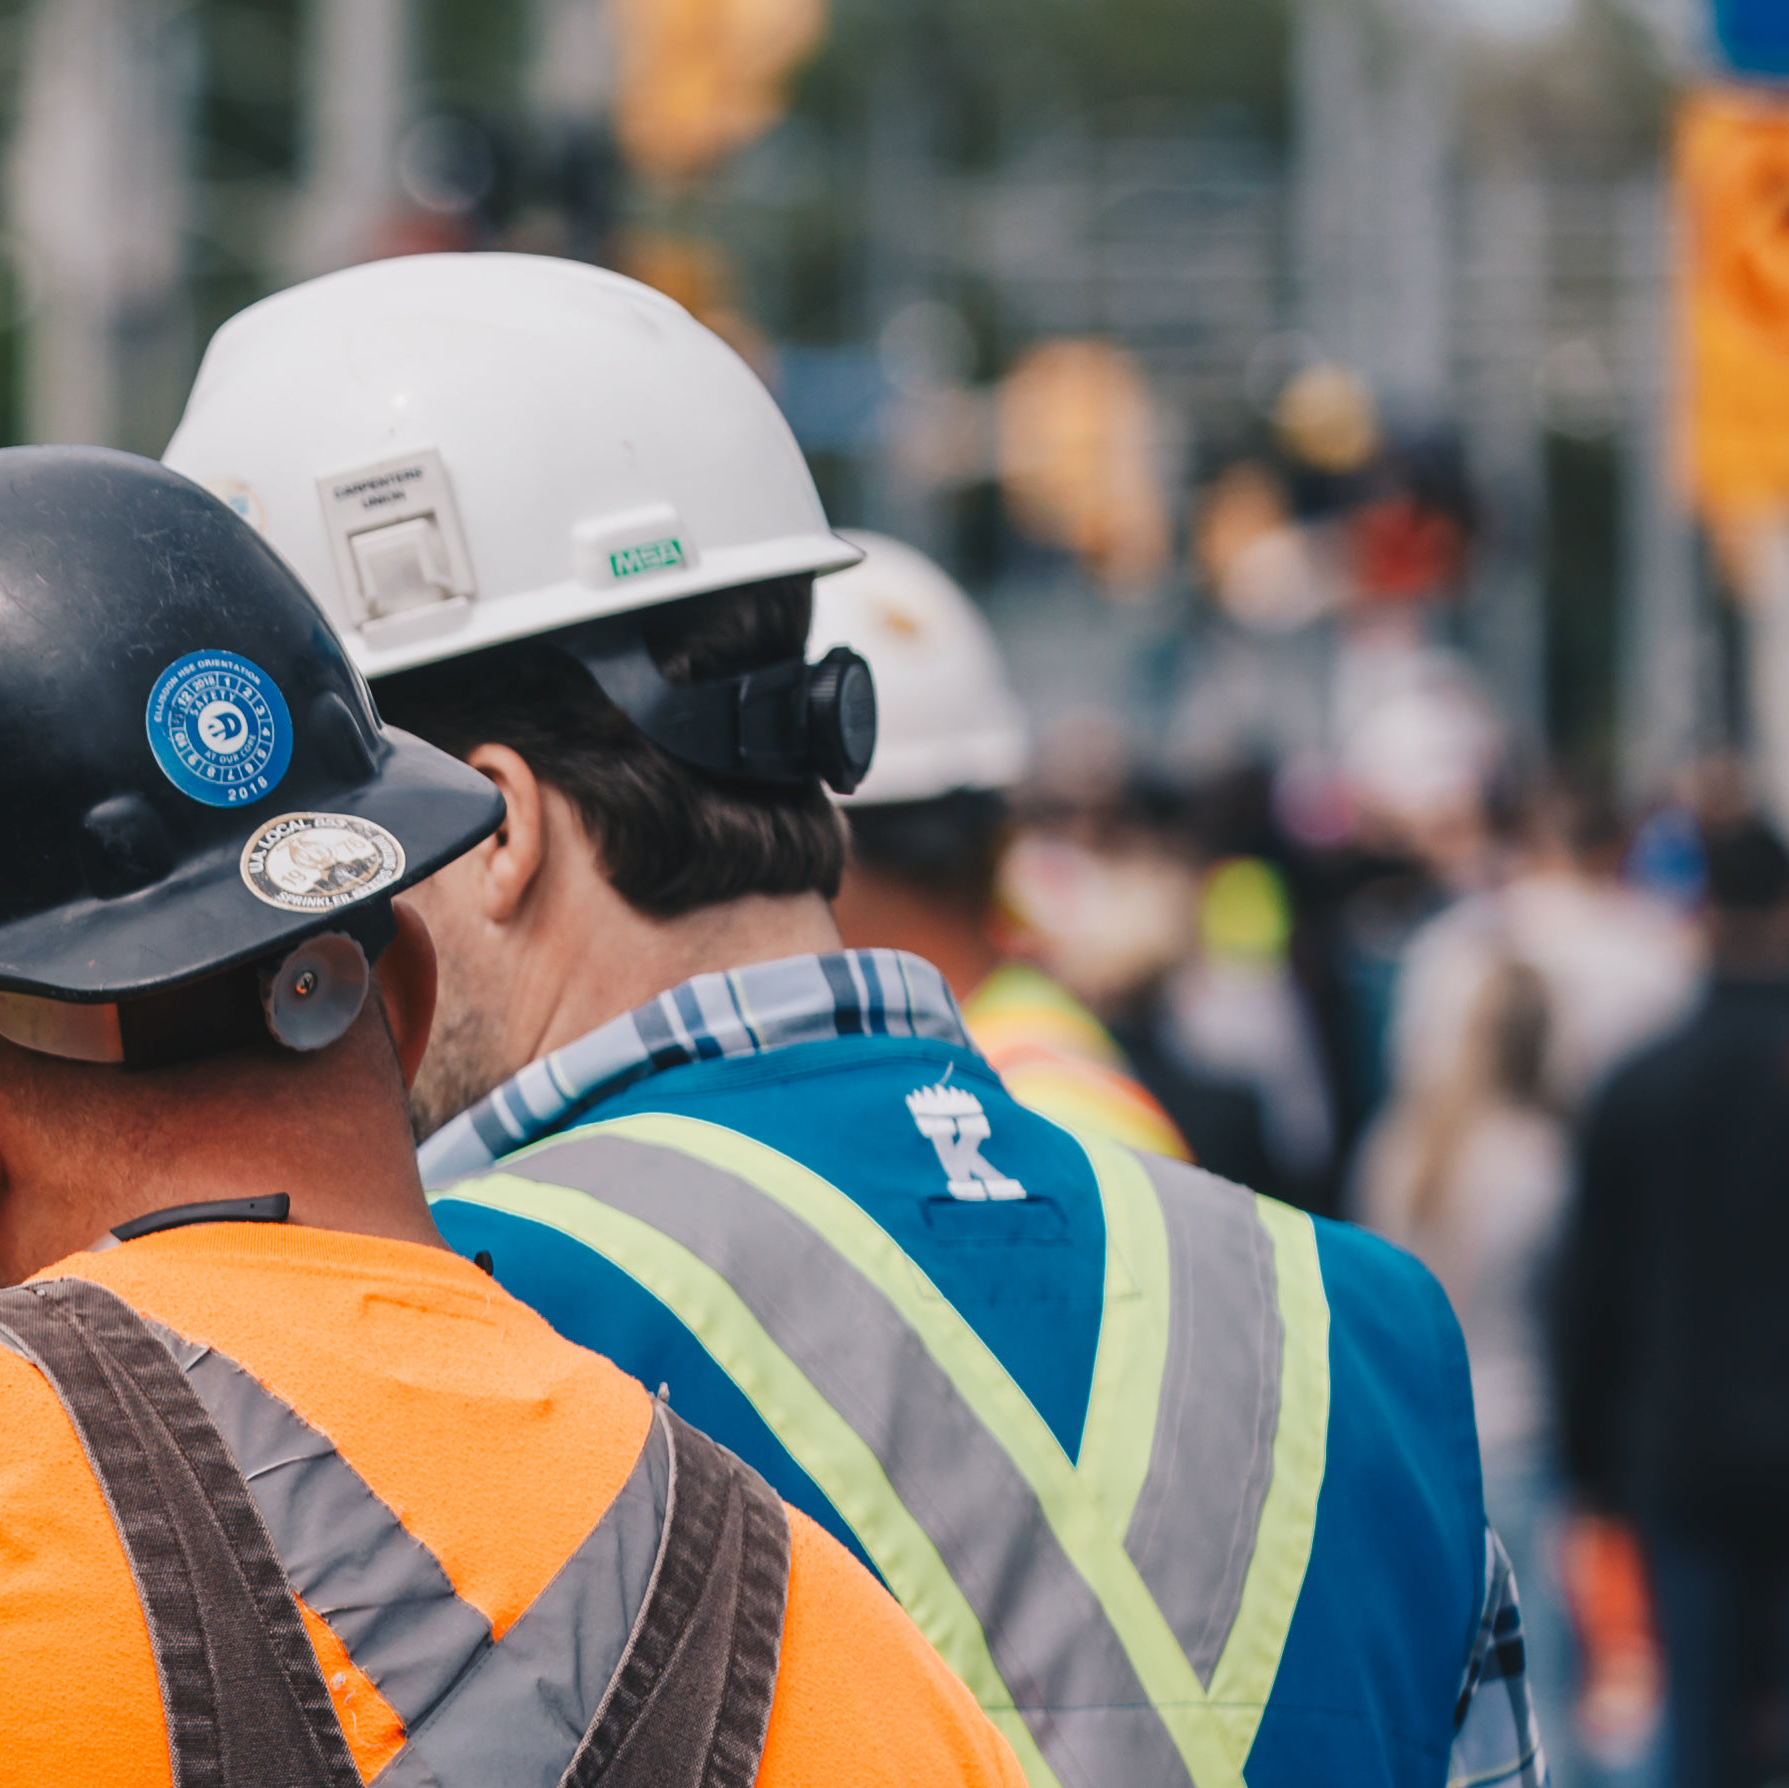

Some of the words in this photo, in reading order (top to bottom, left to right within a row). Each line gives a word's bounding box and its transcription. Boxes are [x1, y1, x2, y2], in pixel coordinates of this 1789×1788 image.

[361, 488, 408, 511] UNION
[153, 675, 179, 723] ELLISDON
[177, 662, 197, 678] HSE
[197, 658, 261, 686] ORIENTATION
[224, 676, 231, 688] 1
[242, 686, 253, 699] 2
[189, 688, 237, 718] SAFETY
[255, 704, 266, 716] 3
[261, 726, 271, 738] 4
[204, 750, 217, 762] AT
[219, 753, 240, 765] OUR
[240, 733, 257, 758] CORE
[227, 768, 236, 781] 7
[227, 775, 268, 802] 2018
[258, 817, 312, 848] LOCAL
